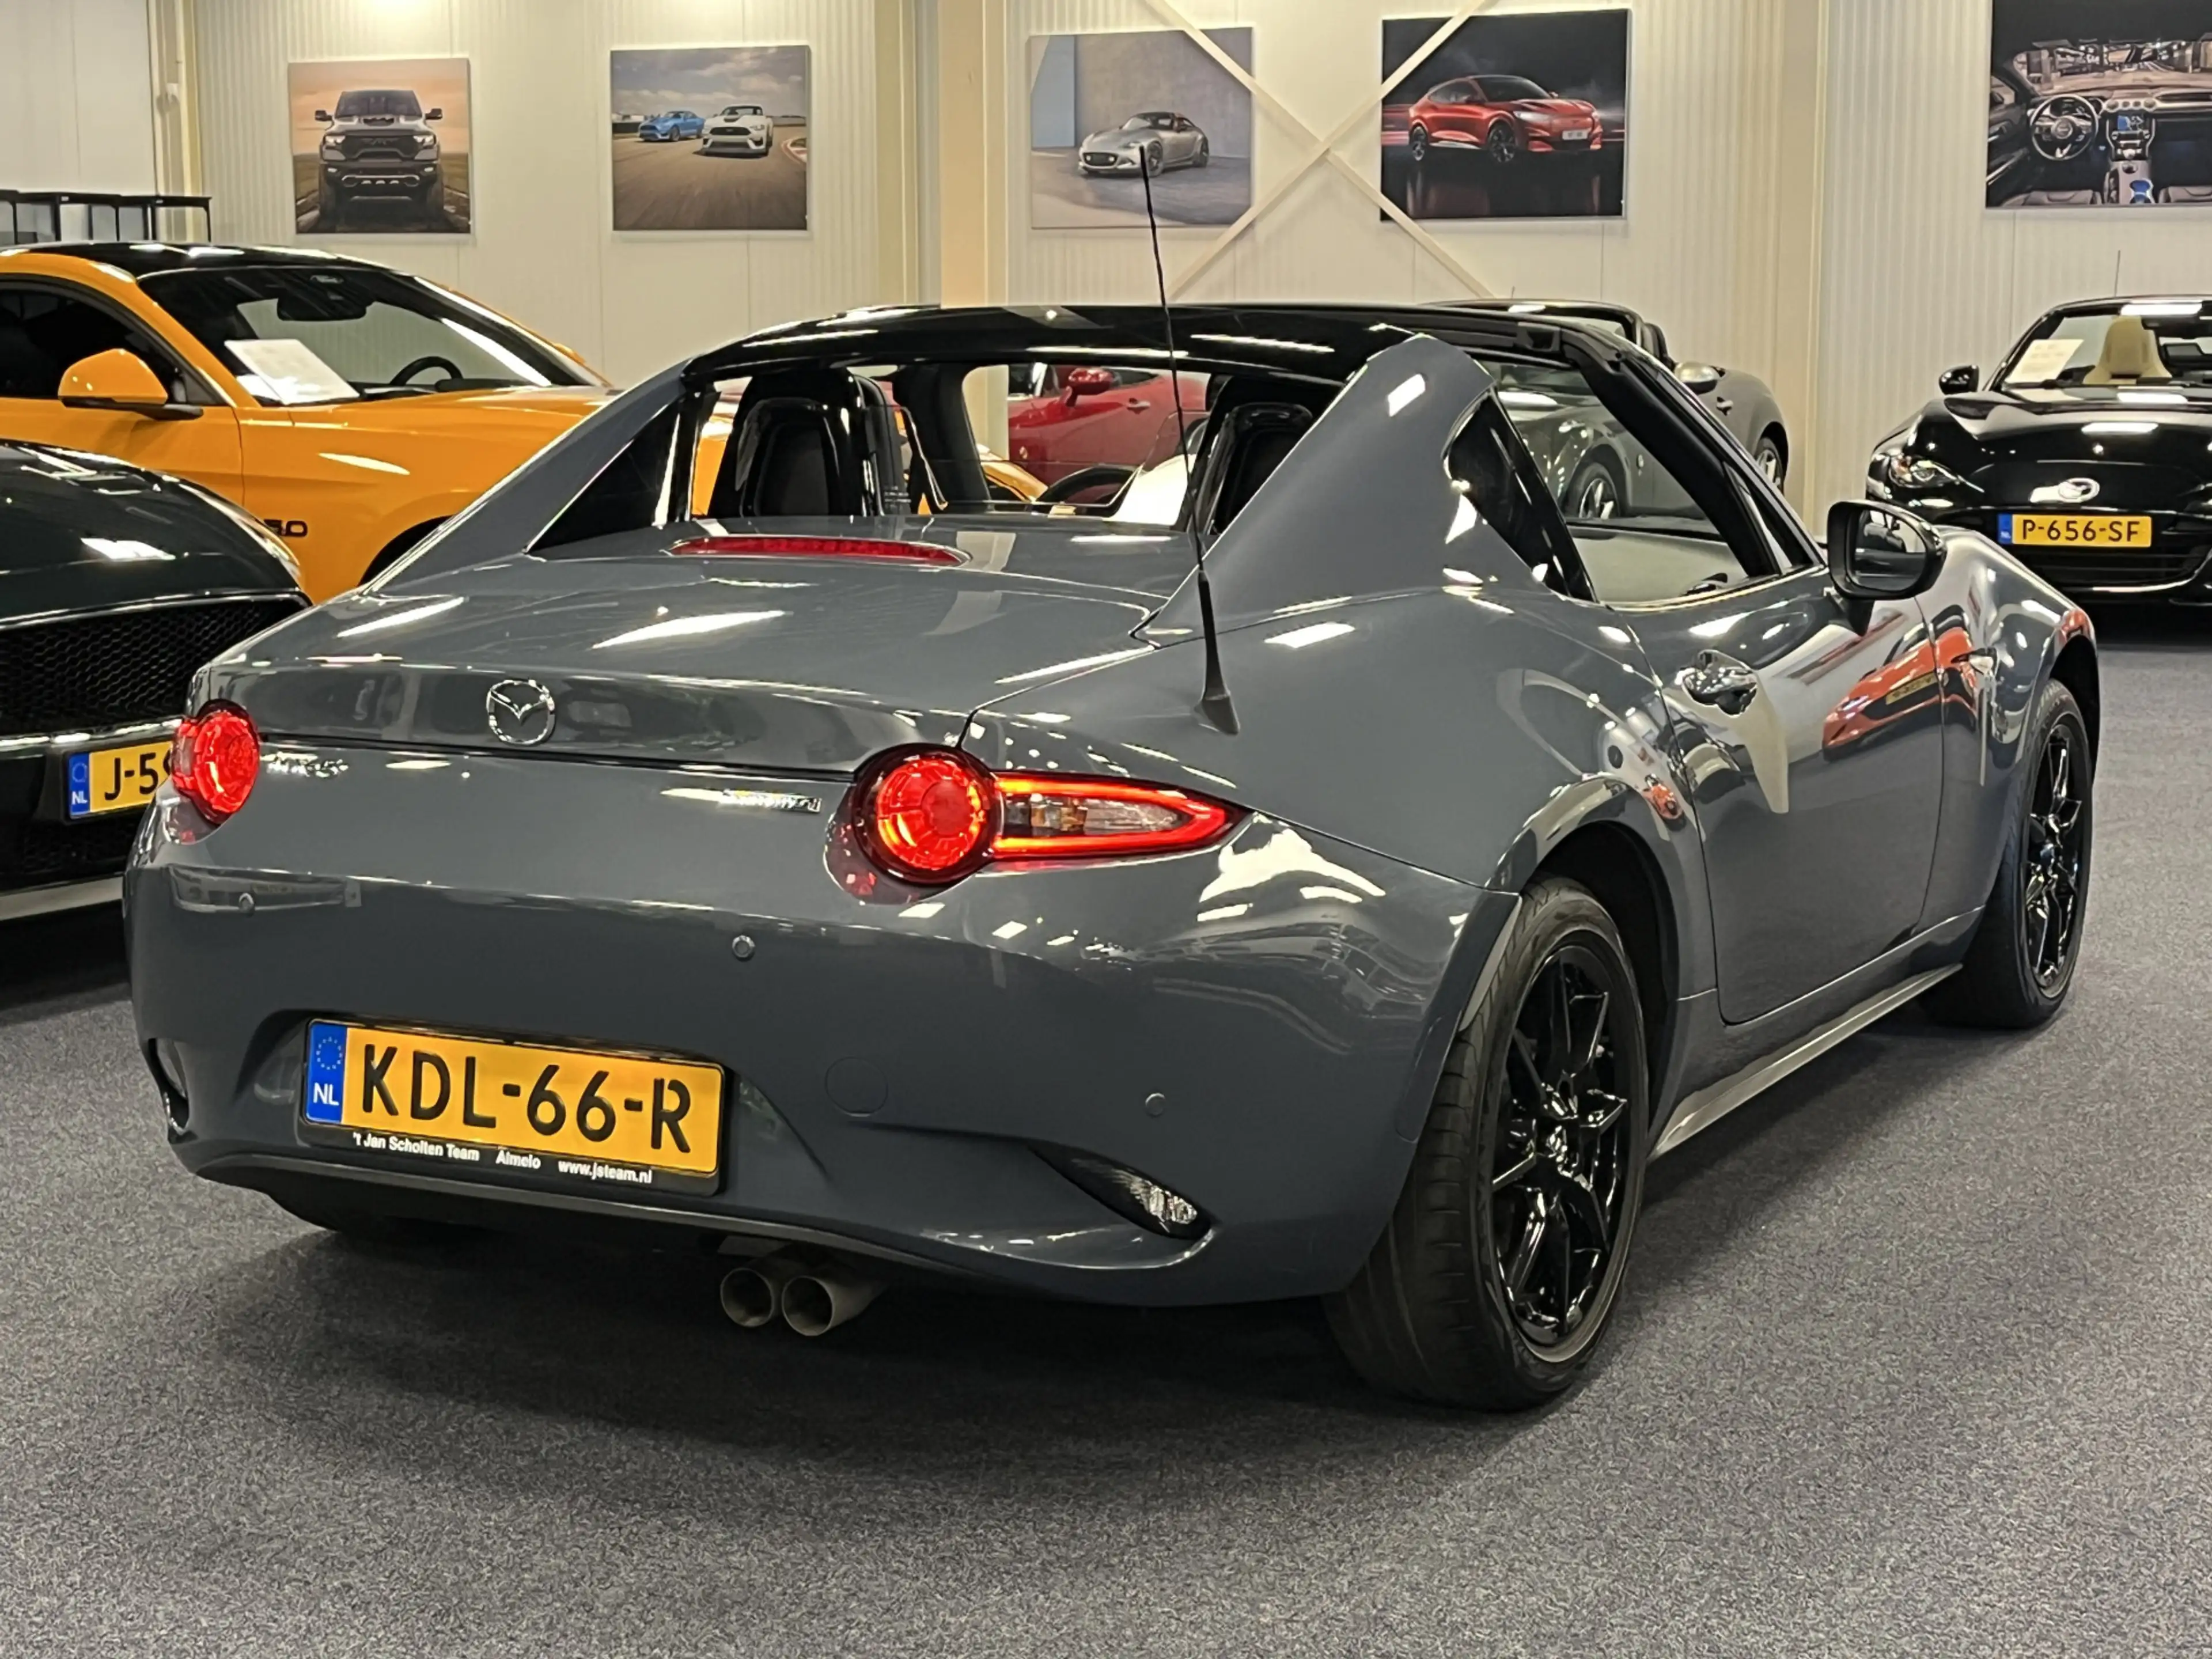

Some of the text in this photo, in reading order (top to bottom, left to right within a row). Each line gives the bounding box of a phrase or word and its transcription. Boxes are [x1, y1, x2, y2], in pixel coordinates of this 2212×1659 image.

[2022, 519, 2140, 541] P-656-SF
[71, 790, 88, 805] NL
[313, 1083, 339, 1106] NL
[362, 1044, 691, 1153] KDL-66-R
[363, 1133, 386, 1149] Jan
[389, 1135, 444, 1157] Scholten
[446, 1143, 480, 1161] Team
[495, 1149, 541, 1169] Almelo
[558, 1160, 653, 1184] www.jsteam.nl
